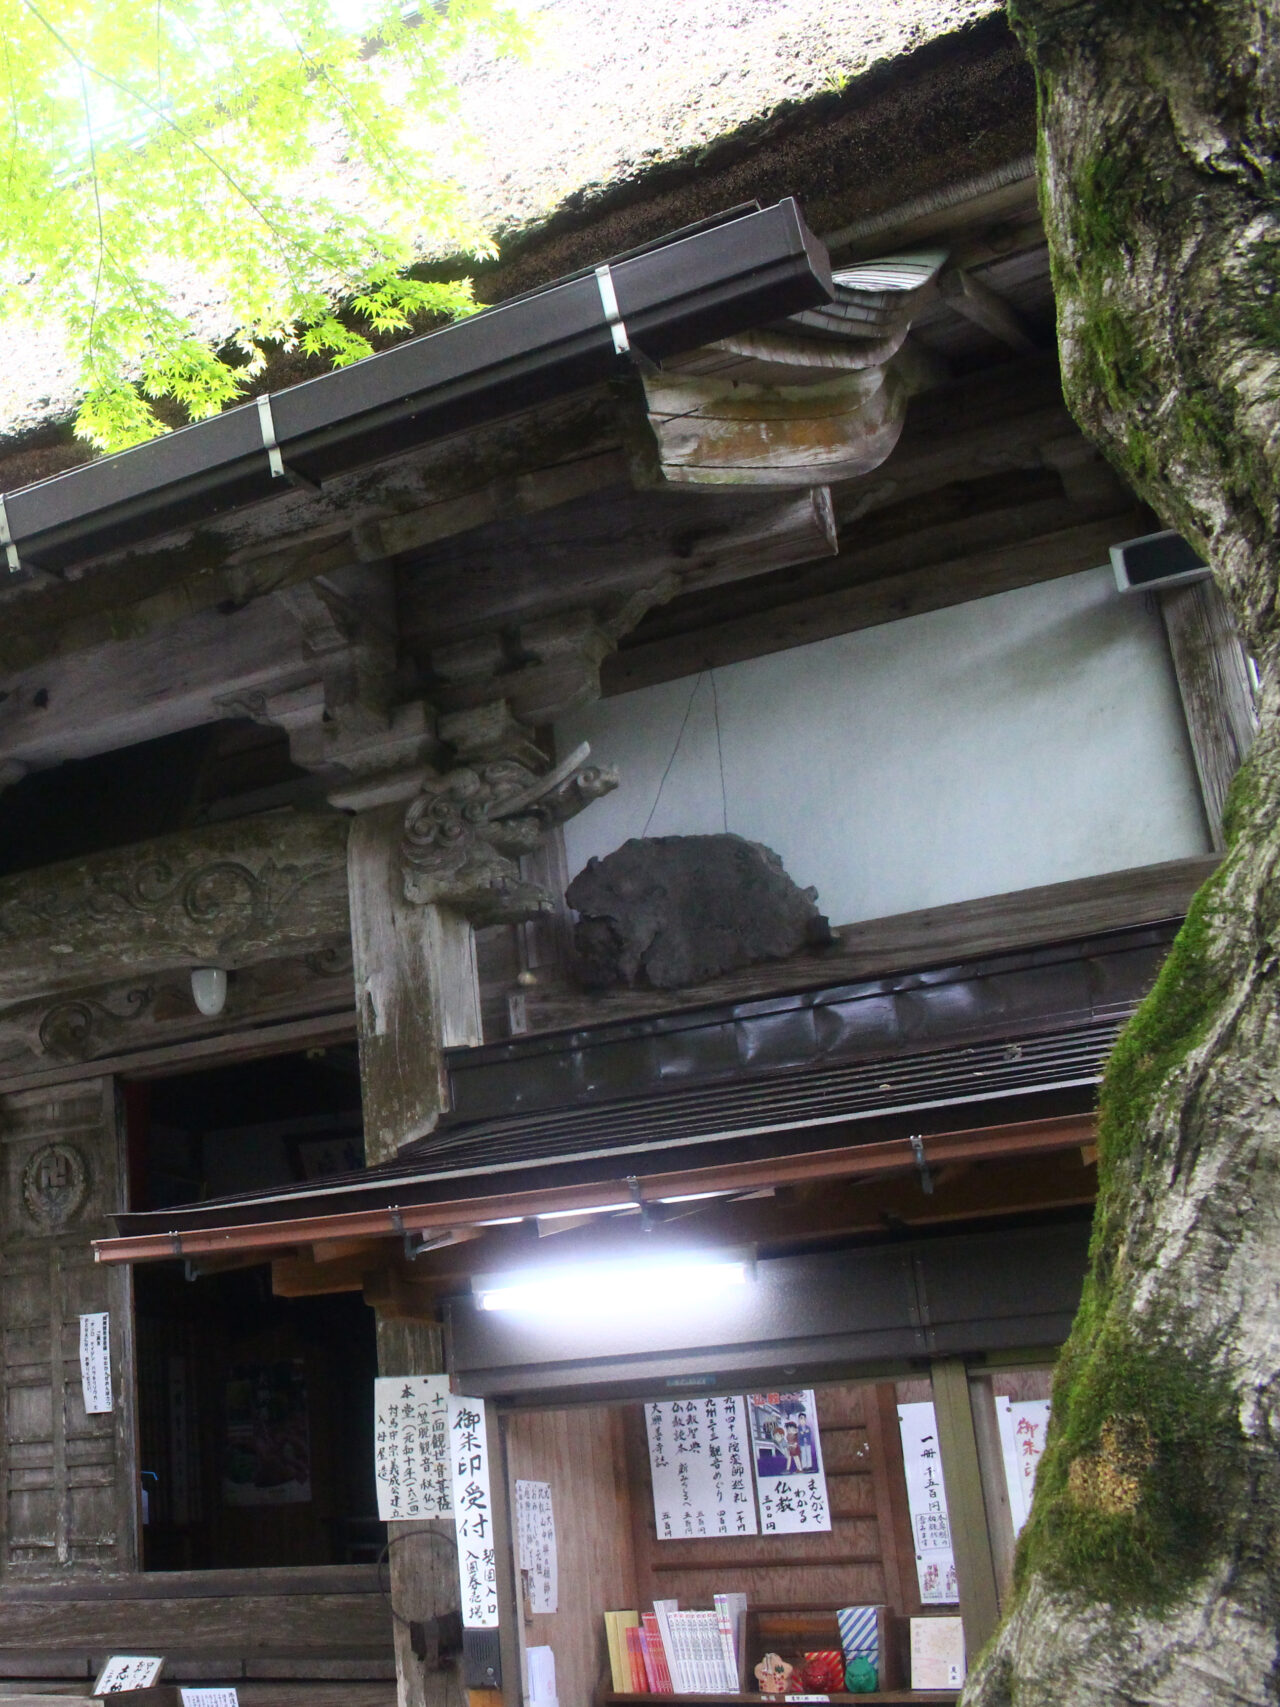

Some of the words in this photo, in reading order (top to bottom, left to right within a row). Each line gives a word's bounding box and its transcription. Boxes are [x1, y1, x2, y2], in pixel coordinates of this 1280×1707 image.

[431, 1392, 453, 1511] 十一面観世音菩薩
[671, 1402, 688, 1454] 仏教読本
[686, 1401, 701, 1454] 仏教聖典
[705, 1398, 723, 1502] 九州三十三観音めぐり
[723, 1396, 747, 1503] 九州四十九院薬師巡礼
[921, 1435, 936, 1459] 一冊
[453, 1407, 488, 1539] 御朱印受付
[650, 1403, 669, 1468] 大興善寺誌
[661, 1511, 672, 1537] 五百円
[774, 1480, 796, 1513] 仏教
[924, 1467, 941, 1512] 千五百円
[794, 1488, 808, 1523] わかる
[807, 1478, 824, 1524] まんがで
[465, 1549, 483, 1619] 入園券売場
